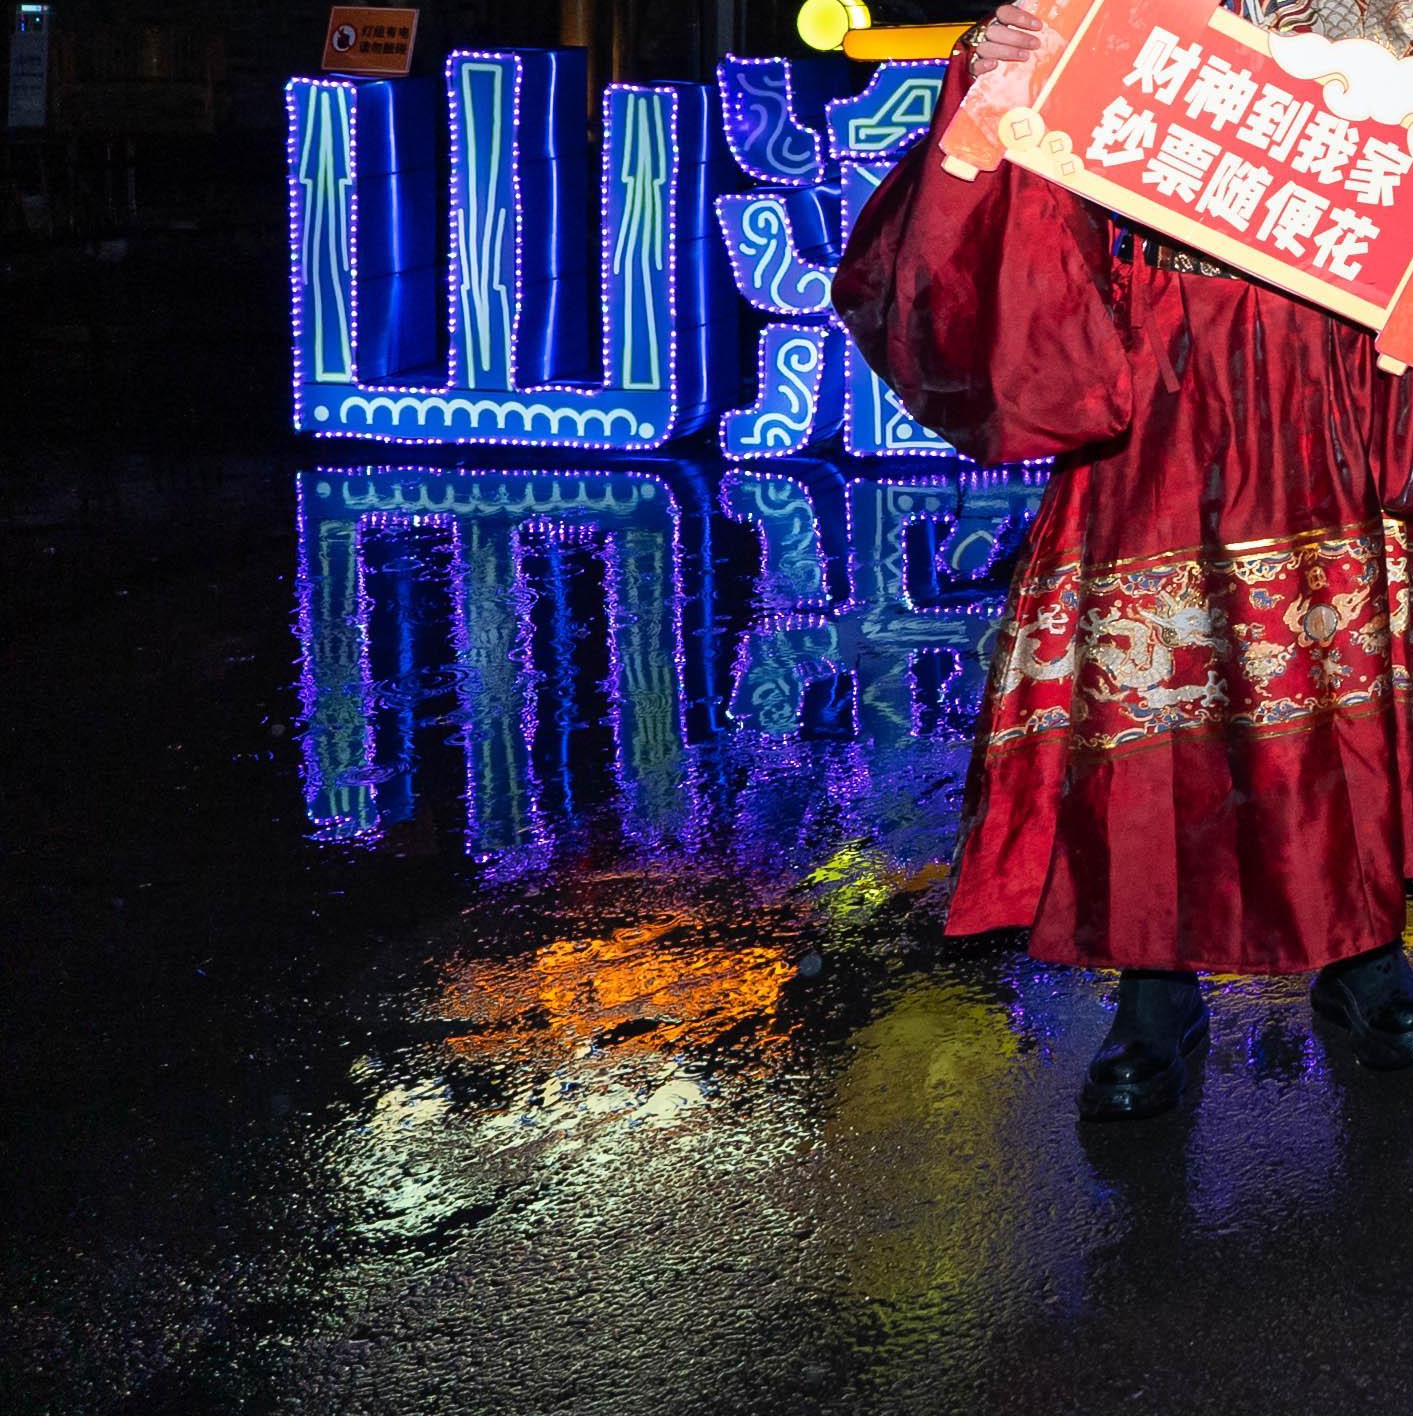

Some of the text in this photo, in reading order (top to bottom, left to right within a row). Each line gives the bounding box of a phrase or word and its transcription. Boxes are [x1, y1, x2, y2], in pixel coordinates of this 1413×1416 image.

[1086, 96, 1381, 281] 钞票随便花
[1123, 27, 1413, 207] 财神到我家
